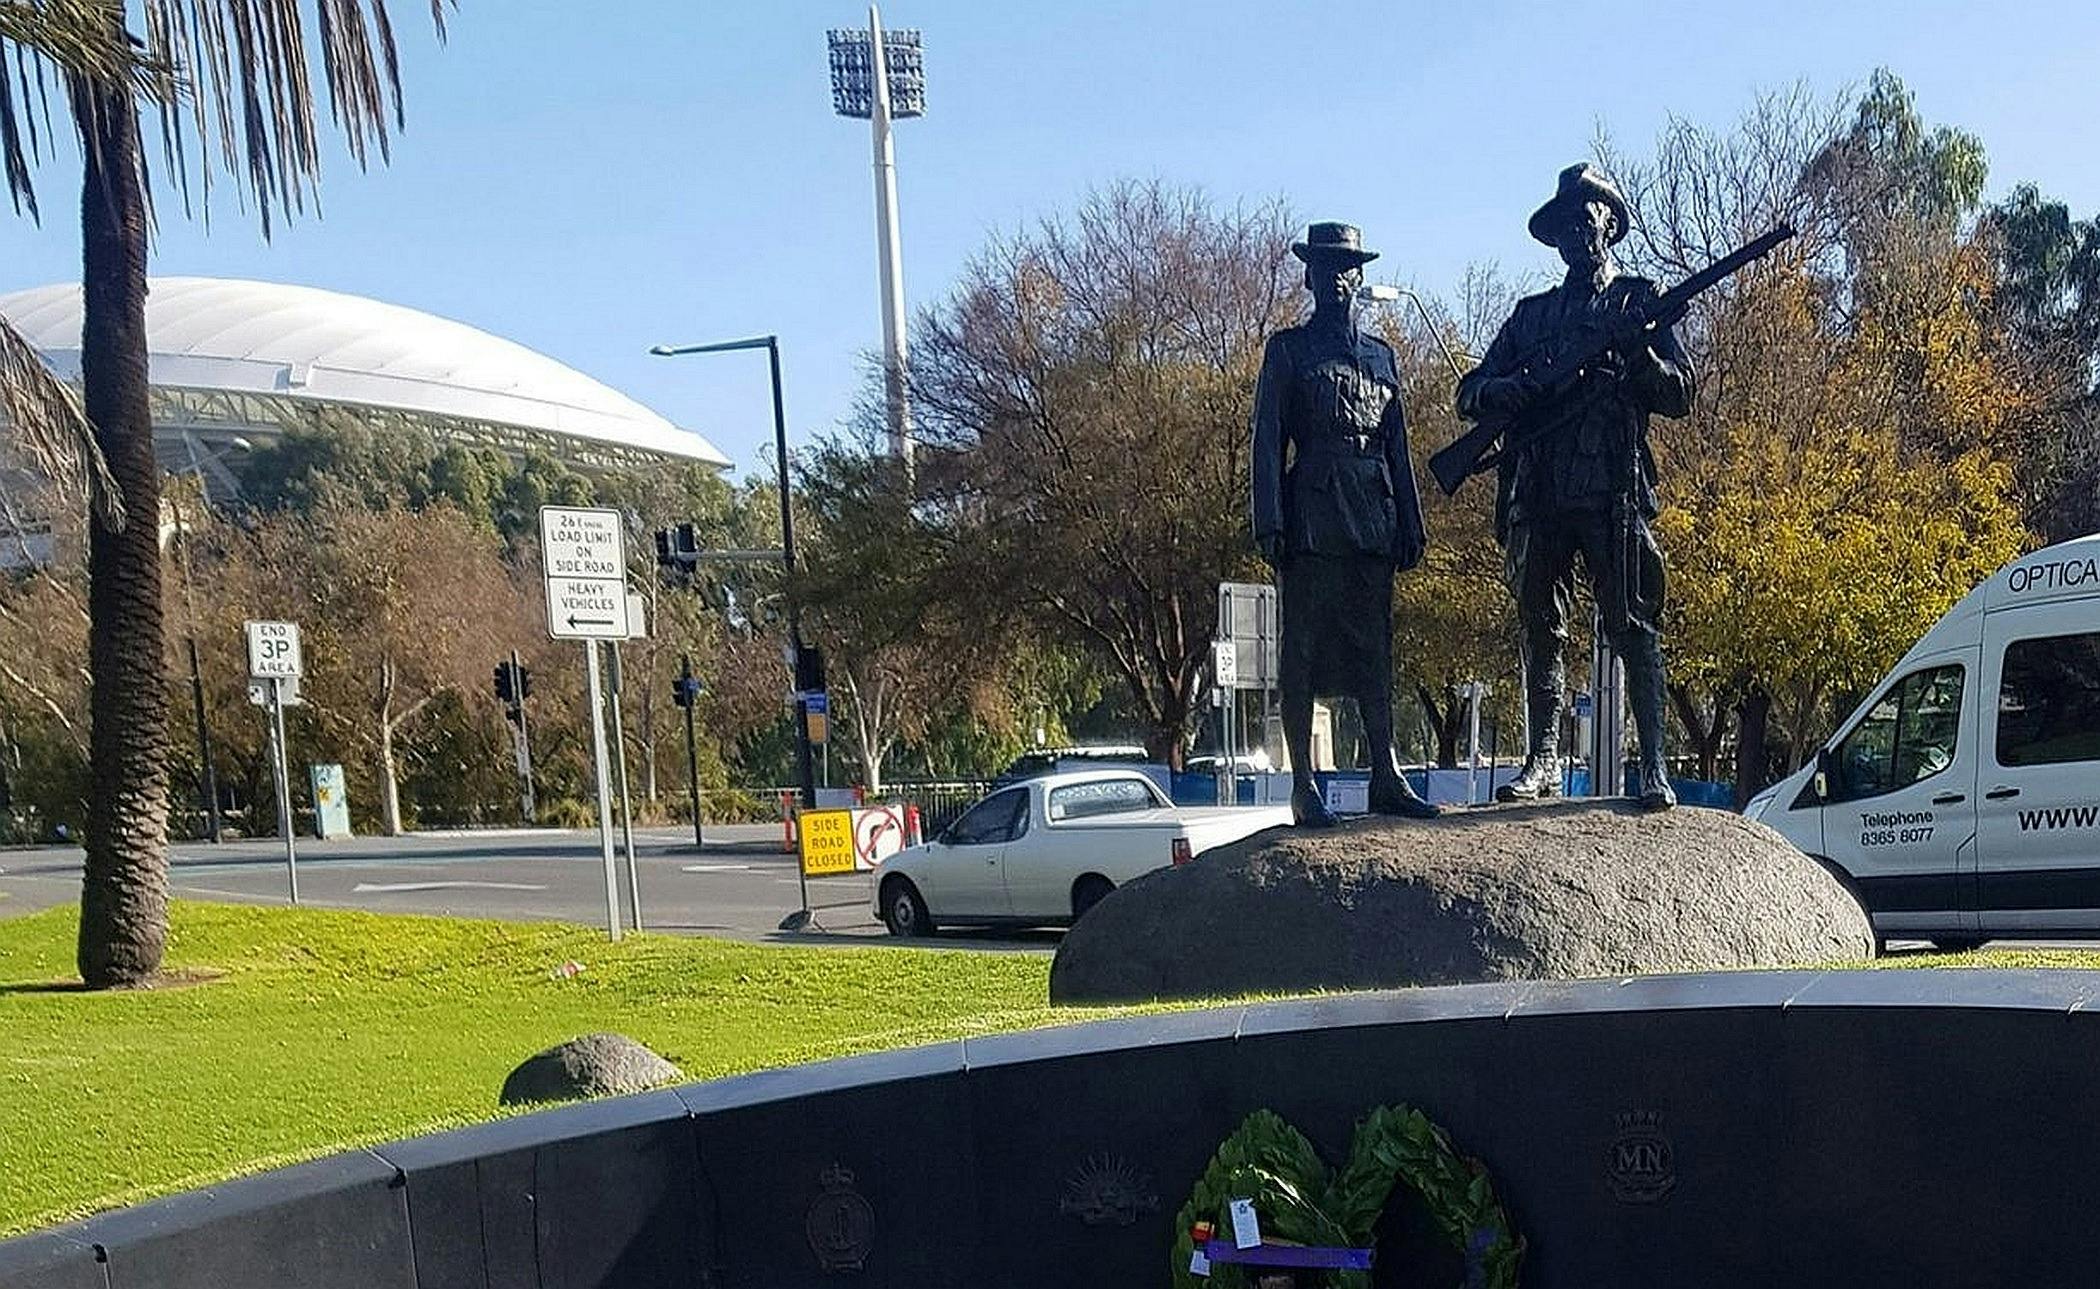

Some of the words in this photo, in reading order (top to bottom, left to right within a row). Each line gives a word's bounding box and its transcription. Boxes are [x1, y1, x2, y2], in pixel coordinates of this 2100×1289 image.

[551, 530, 581, 542] LOAD
[585, 532, 612, 544] LIMIT
[575, 546, 592, 557] ON
[556, 560, 580, 572] SIDE
[585, 562, 614, 573] ROAD
[2008, 559, 2099, 592] OPTICA
[568, 582, 604, 595] HEAVY
[561, 598, 614, 610] VEHICLES
[261, 625, 286, 636] END
[260, 639, 289, 659] 3P
[258, 661, 295, 673] AREA
[813, 819, 840, 831] SIDE
[1860, 811, 1934, 828] Telephone
[812, 837, 844, 849] ROAD
[1861, 830, 1896, 846] 8365
[1900, 827, 1934, 843] 8077
[807, 853, 851, 867] CLOSED
[1615, 1146, 1663, 1172] MN
